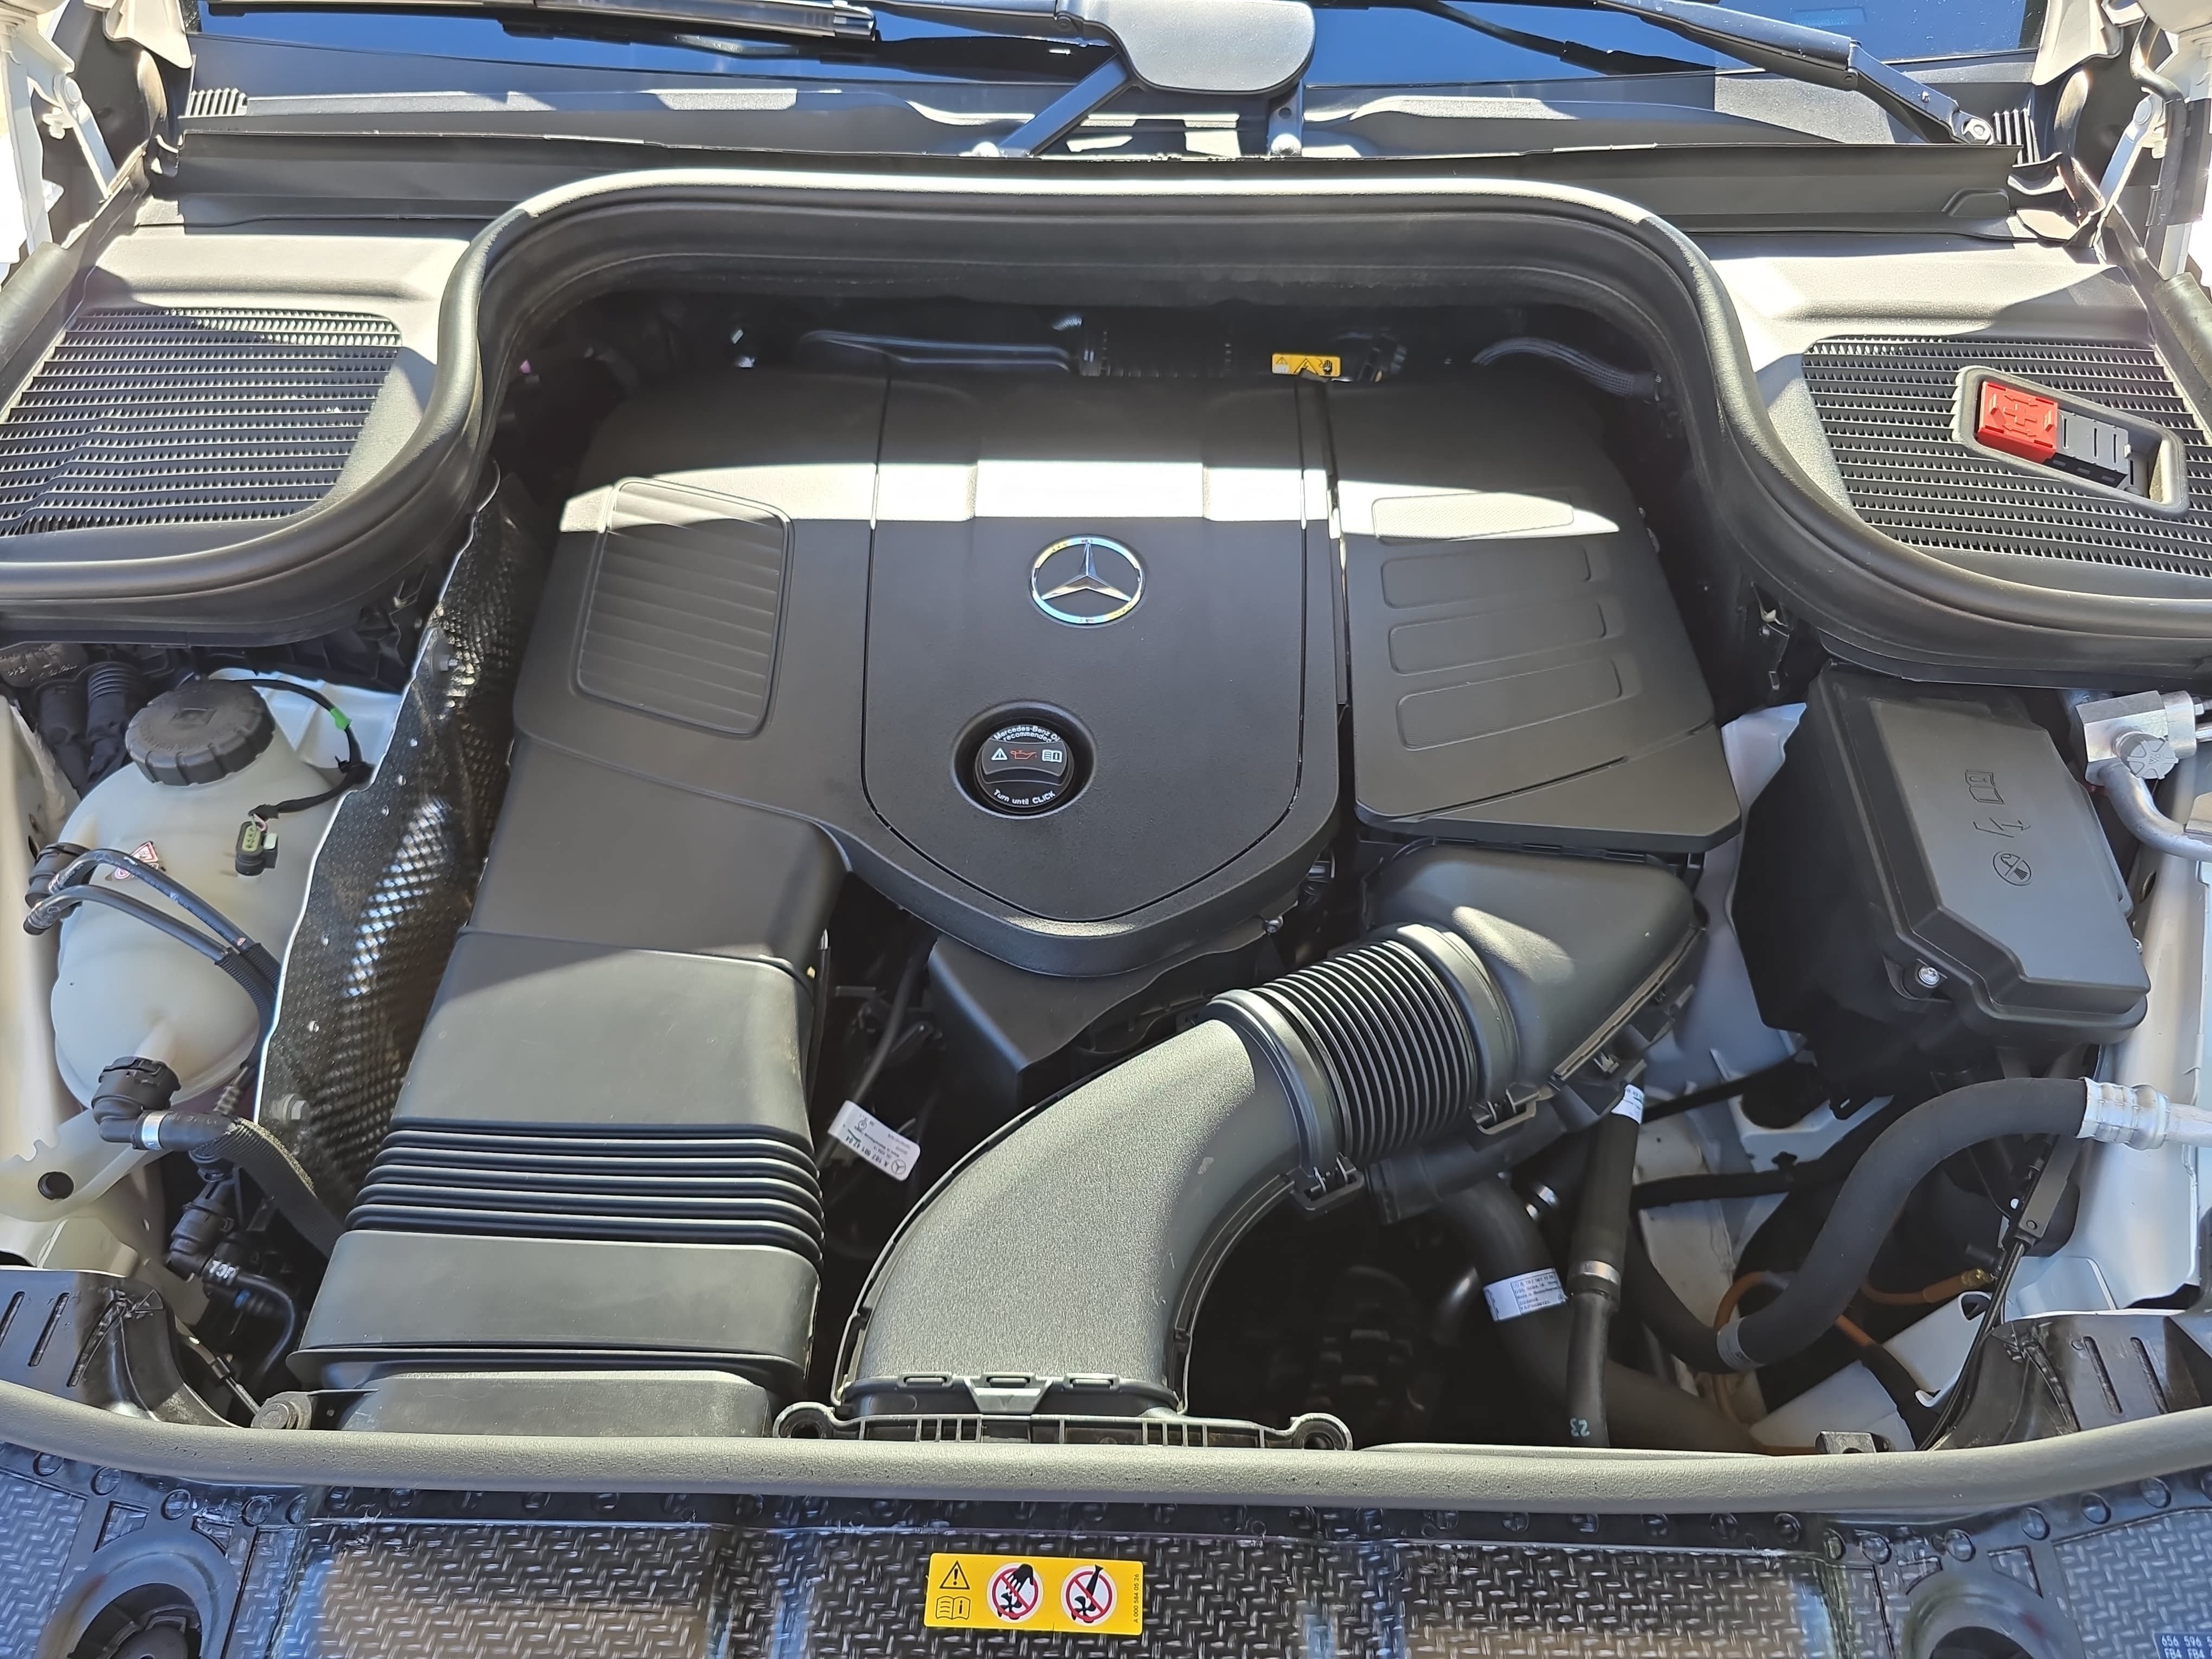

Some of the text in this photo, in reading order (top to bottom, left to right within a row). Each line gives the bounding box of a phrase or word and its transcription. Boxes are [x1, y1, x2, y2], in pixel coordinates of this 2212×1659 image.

[993, 725, 1051, 740] Mercedes-Benz
[1003, 731, 1052, 743] recommended
[993, 789, 1009, 802] Turn
[1032, 790, 1056, 804] CLICK
[1134, 1583, 1139, 1591] 05
[2162, 1635, 2179, 1647] 656
[2183, 1636, 2202, 1648] 596
